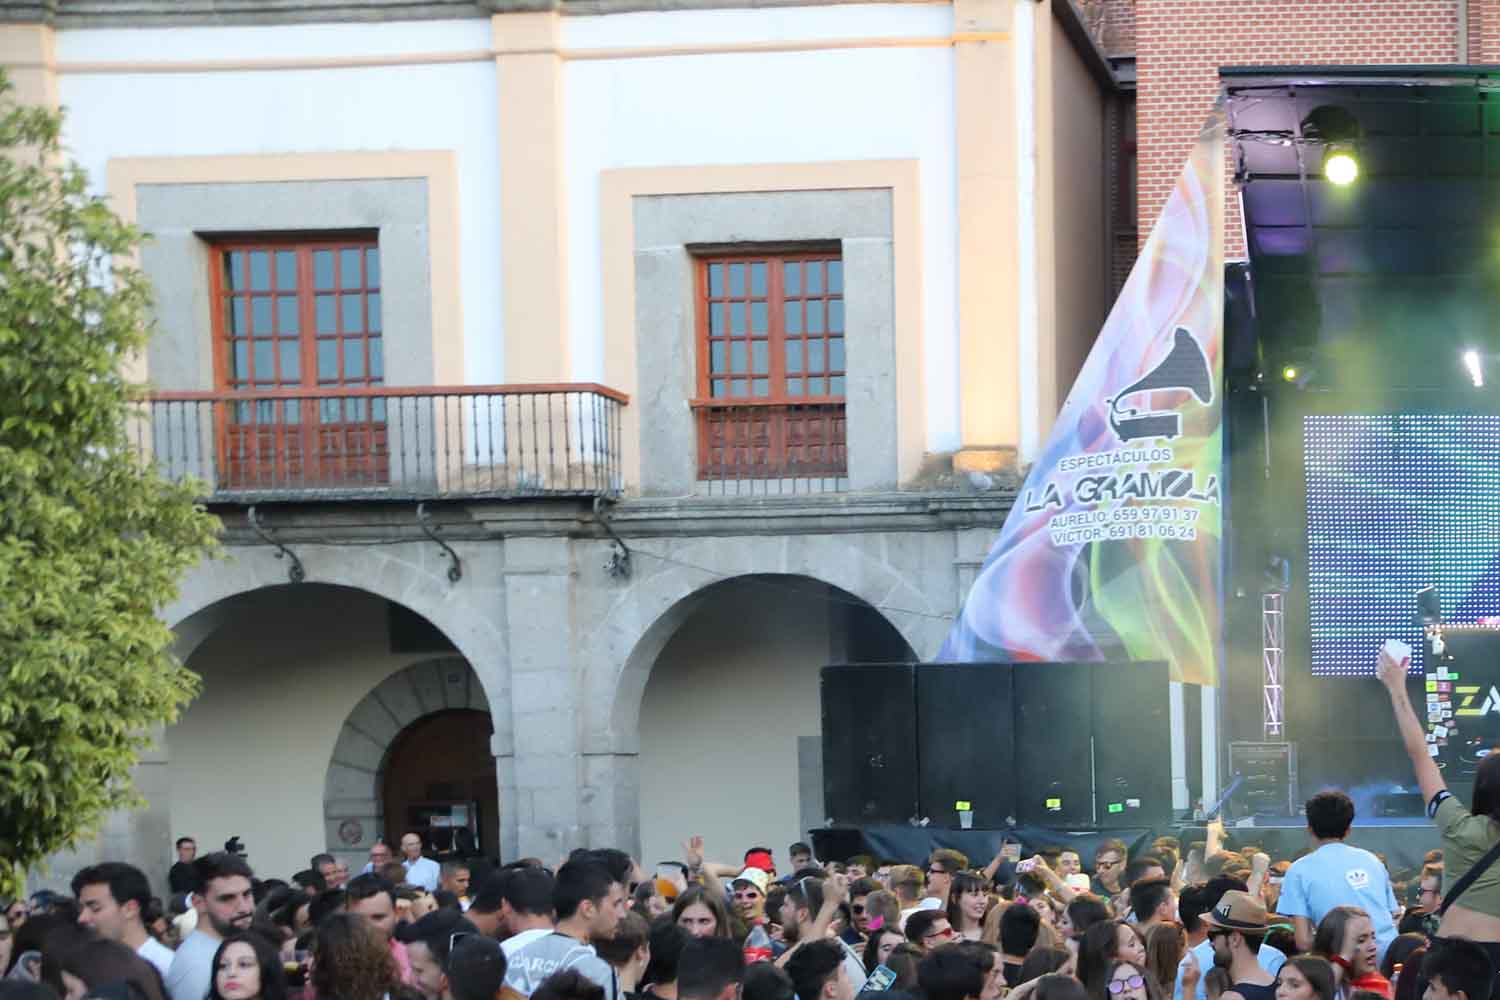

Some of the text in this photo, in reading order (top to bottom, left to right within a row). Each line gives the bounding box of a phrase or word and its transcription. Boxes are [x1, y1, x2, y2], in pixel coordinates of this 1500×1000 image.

[1025, 470, 1219, 512] LA GRAMOLA
[1113, 509, 1137, 521] 659
[1143, 508, 1158, 519] 97
[1163, 508, 1178, 519] 91
[1184, 509, 1199, 521] 37
[1110, 525, 1133, 538] 691
[1138, 525, 1153, 536] 81
[1159, 525, 1176, 537] 06
[1180, 525, 1195, 538] 24
